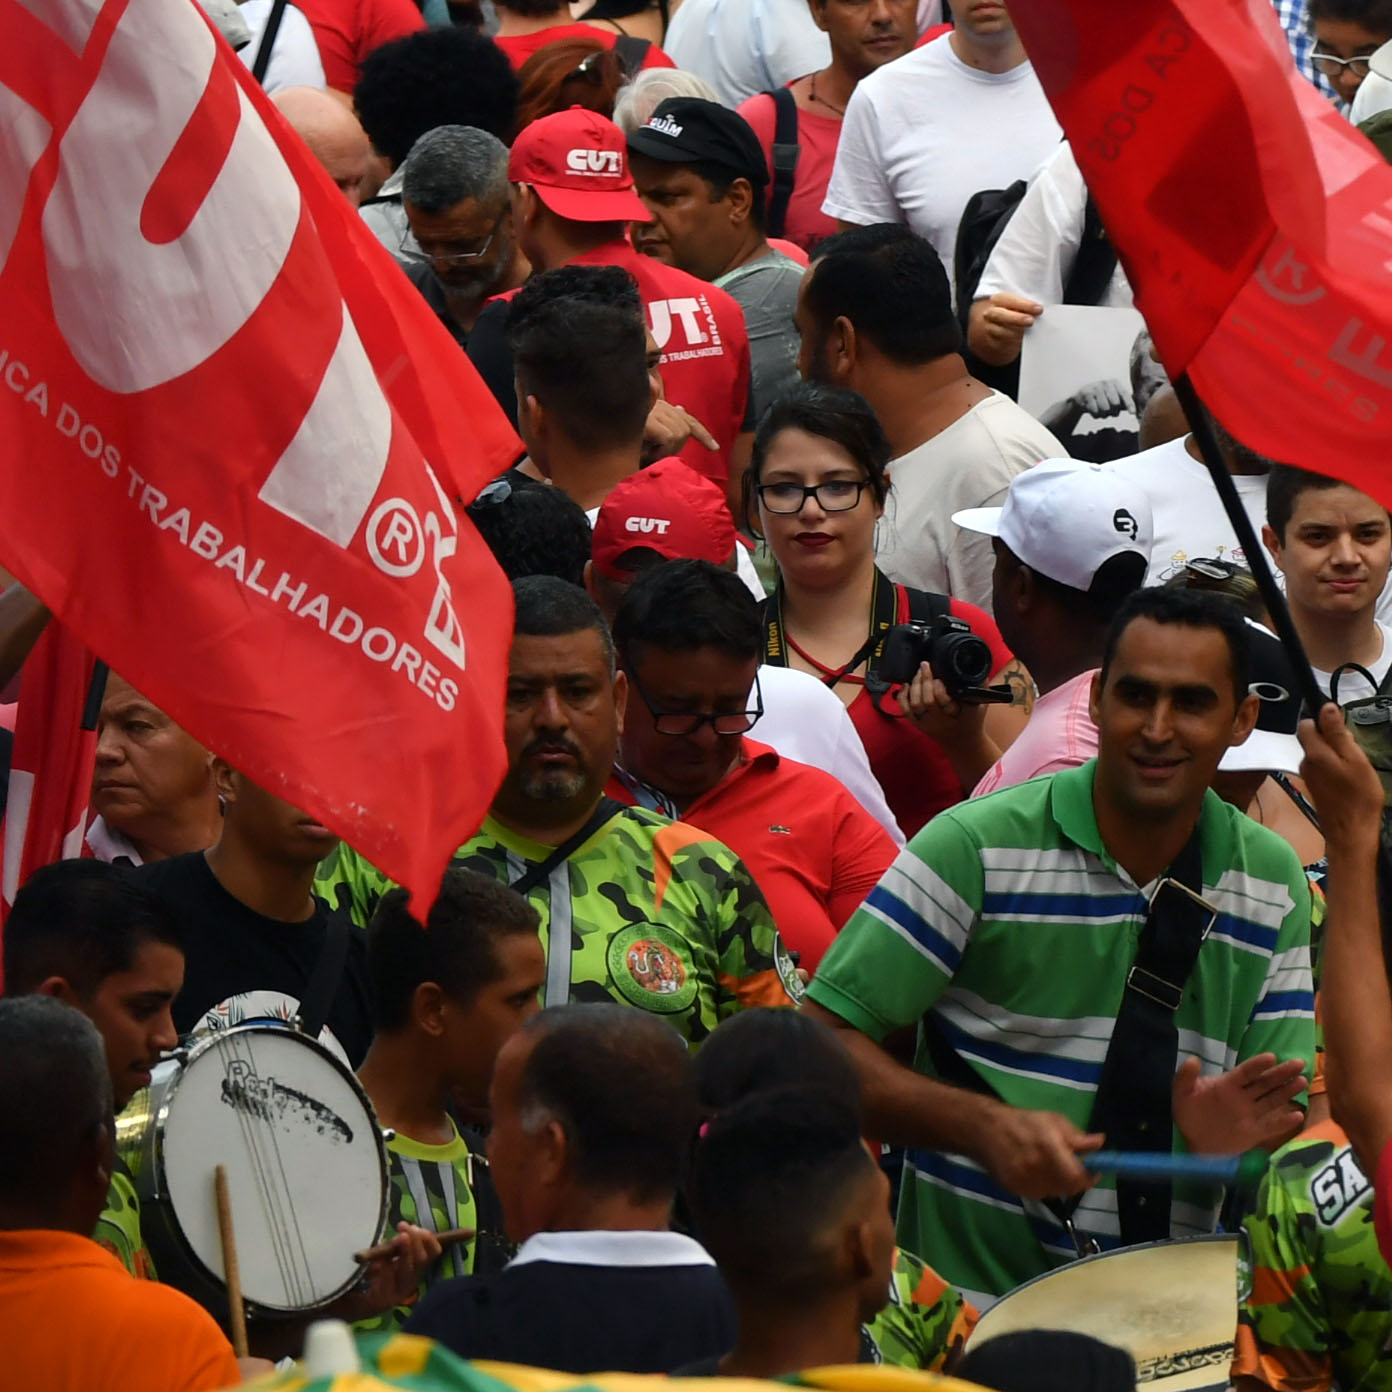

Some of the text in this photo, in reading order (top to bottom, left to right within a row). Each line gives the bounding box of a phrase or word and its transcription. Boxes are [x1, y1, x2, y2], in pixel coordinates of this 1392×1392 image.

[566, 148, 618, 172] CUT
[698, 293, 722, 346] BRASIL
[625, 516, 671, 535] CUT
[55, 401, 121, 479] DOS
[126, 464, 460, 713] TRABALHADORES
[768, 621, 780, 657] Nikon
